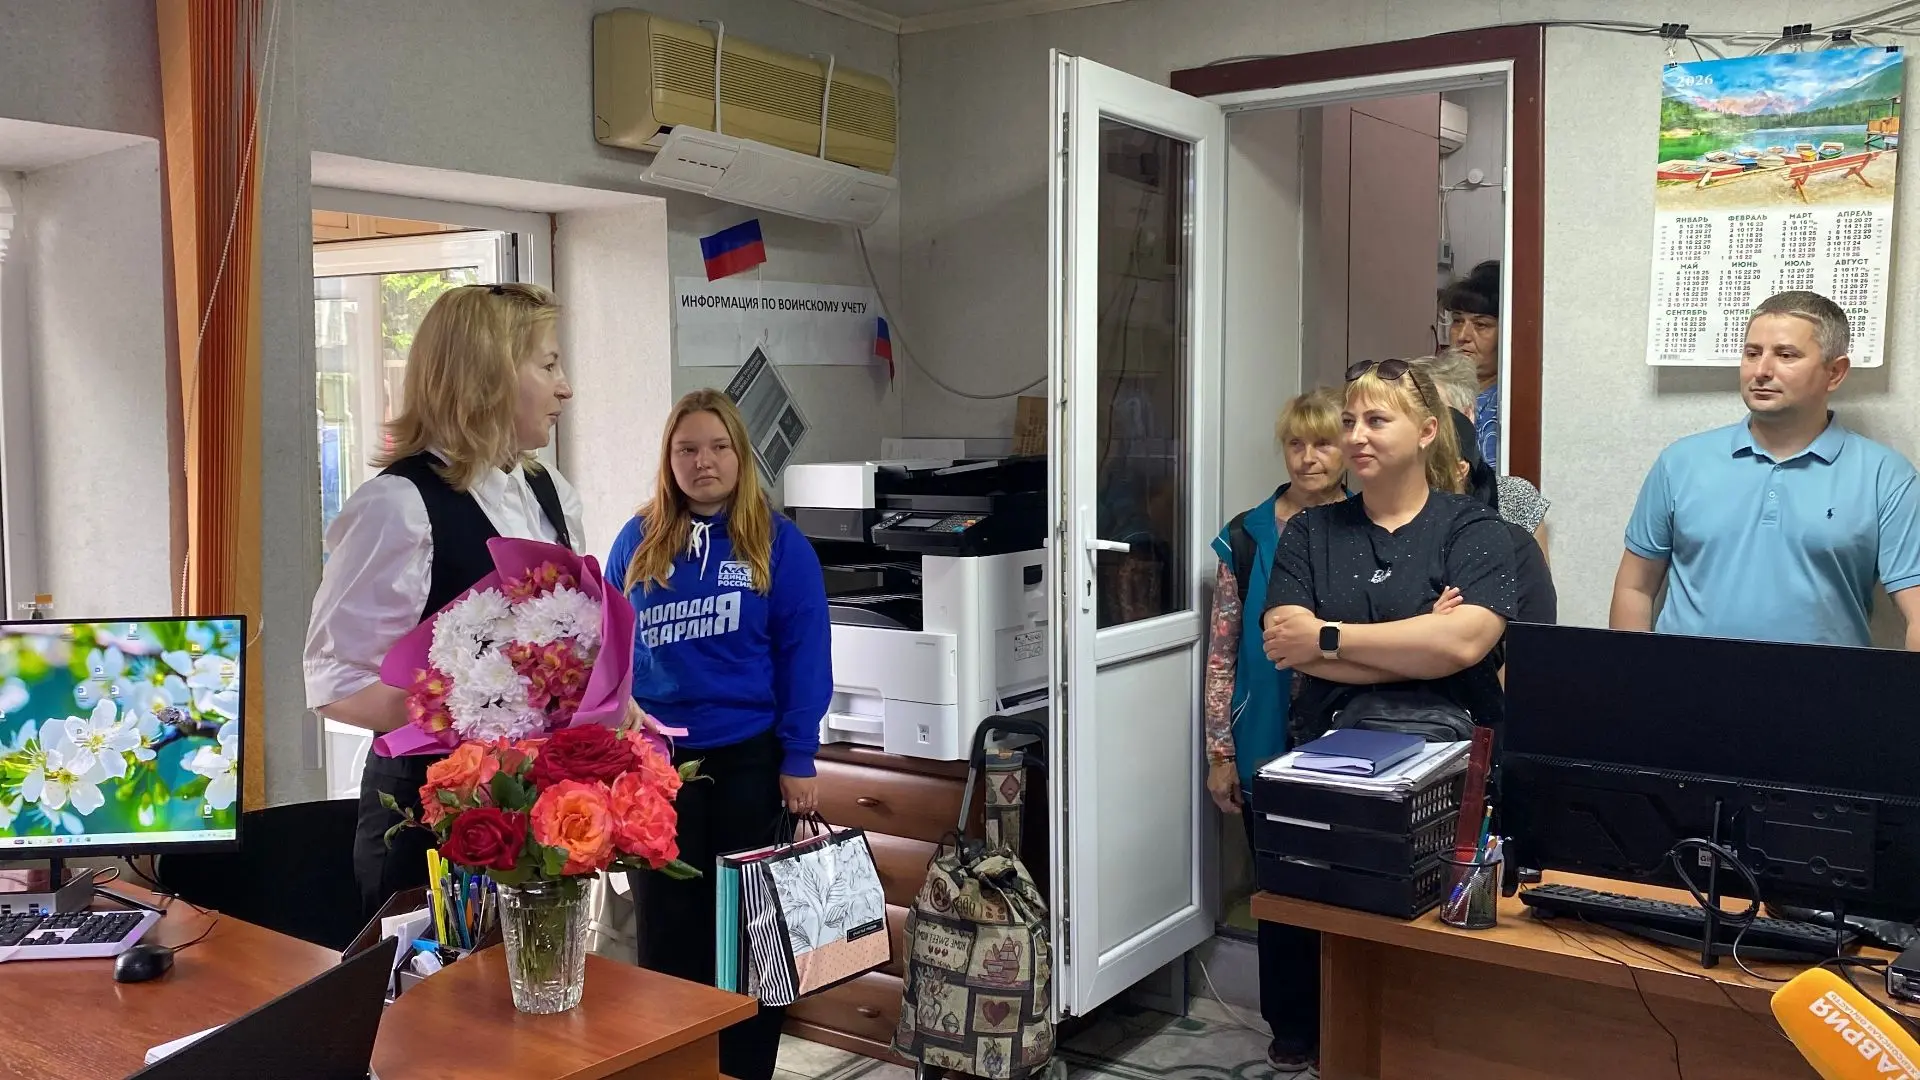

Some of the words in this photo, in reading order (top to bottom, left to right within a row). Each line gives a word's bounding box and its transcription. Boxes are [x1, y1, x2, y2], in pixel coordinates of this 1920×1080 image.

[1677, 74, 1713, 87] 2026
[681, 294, 759, 311] ИНФОРМАЦИЯ
[761, 298, 776, 310] ПО
[778, 299, 839, 312] ВОИНСКОМУ
[841, 301, 867, 314] УЧЕТУ
